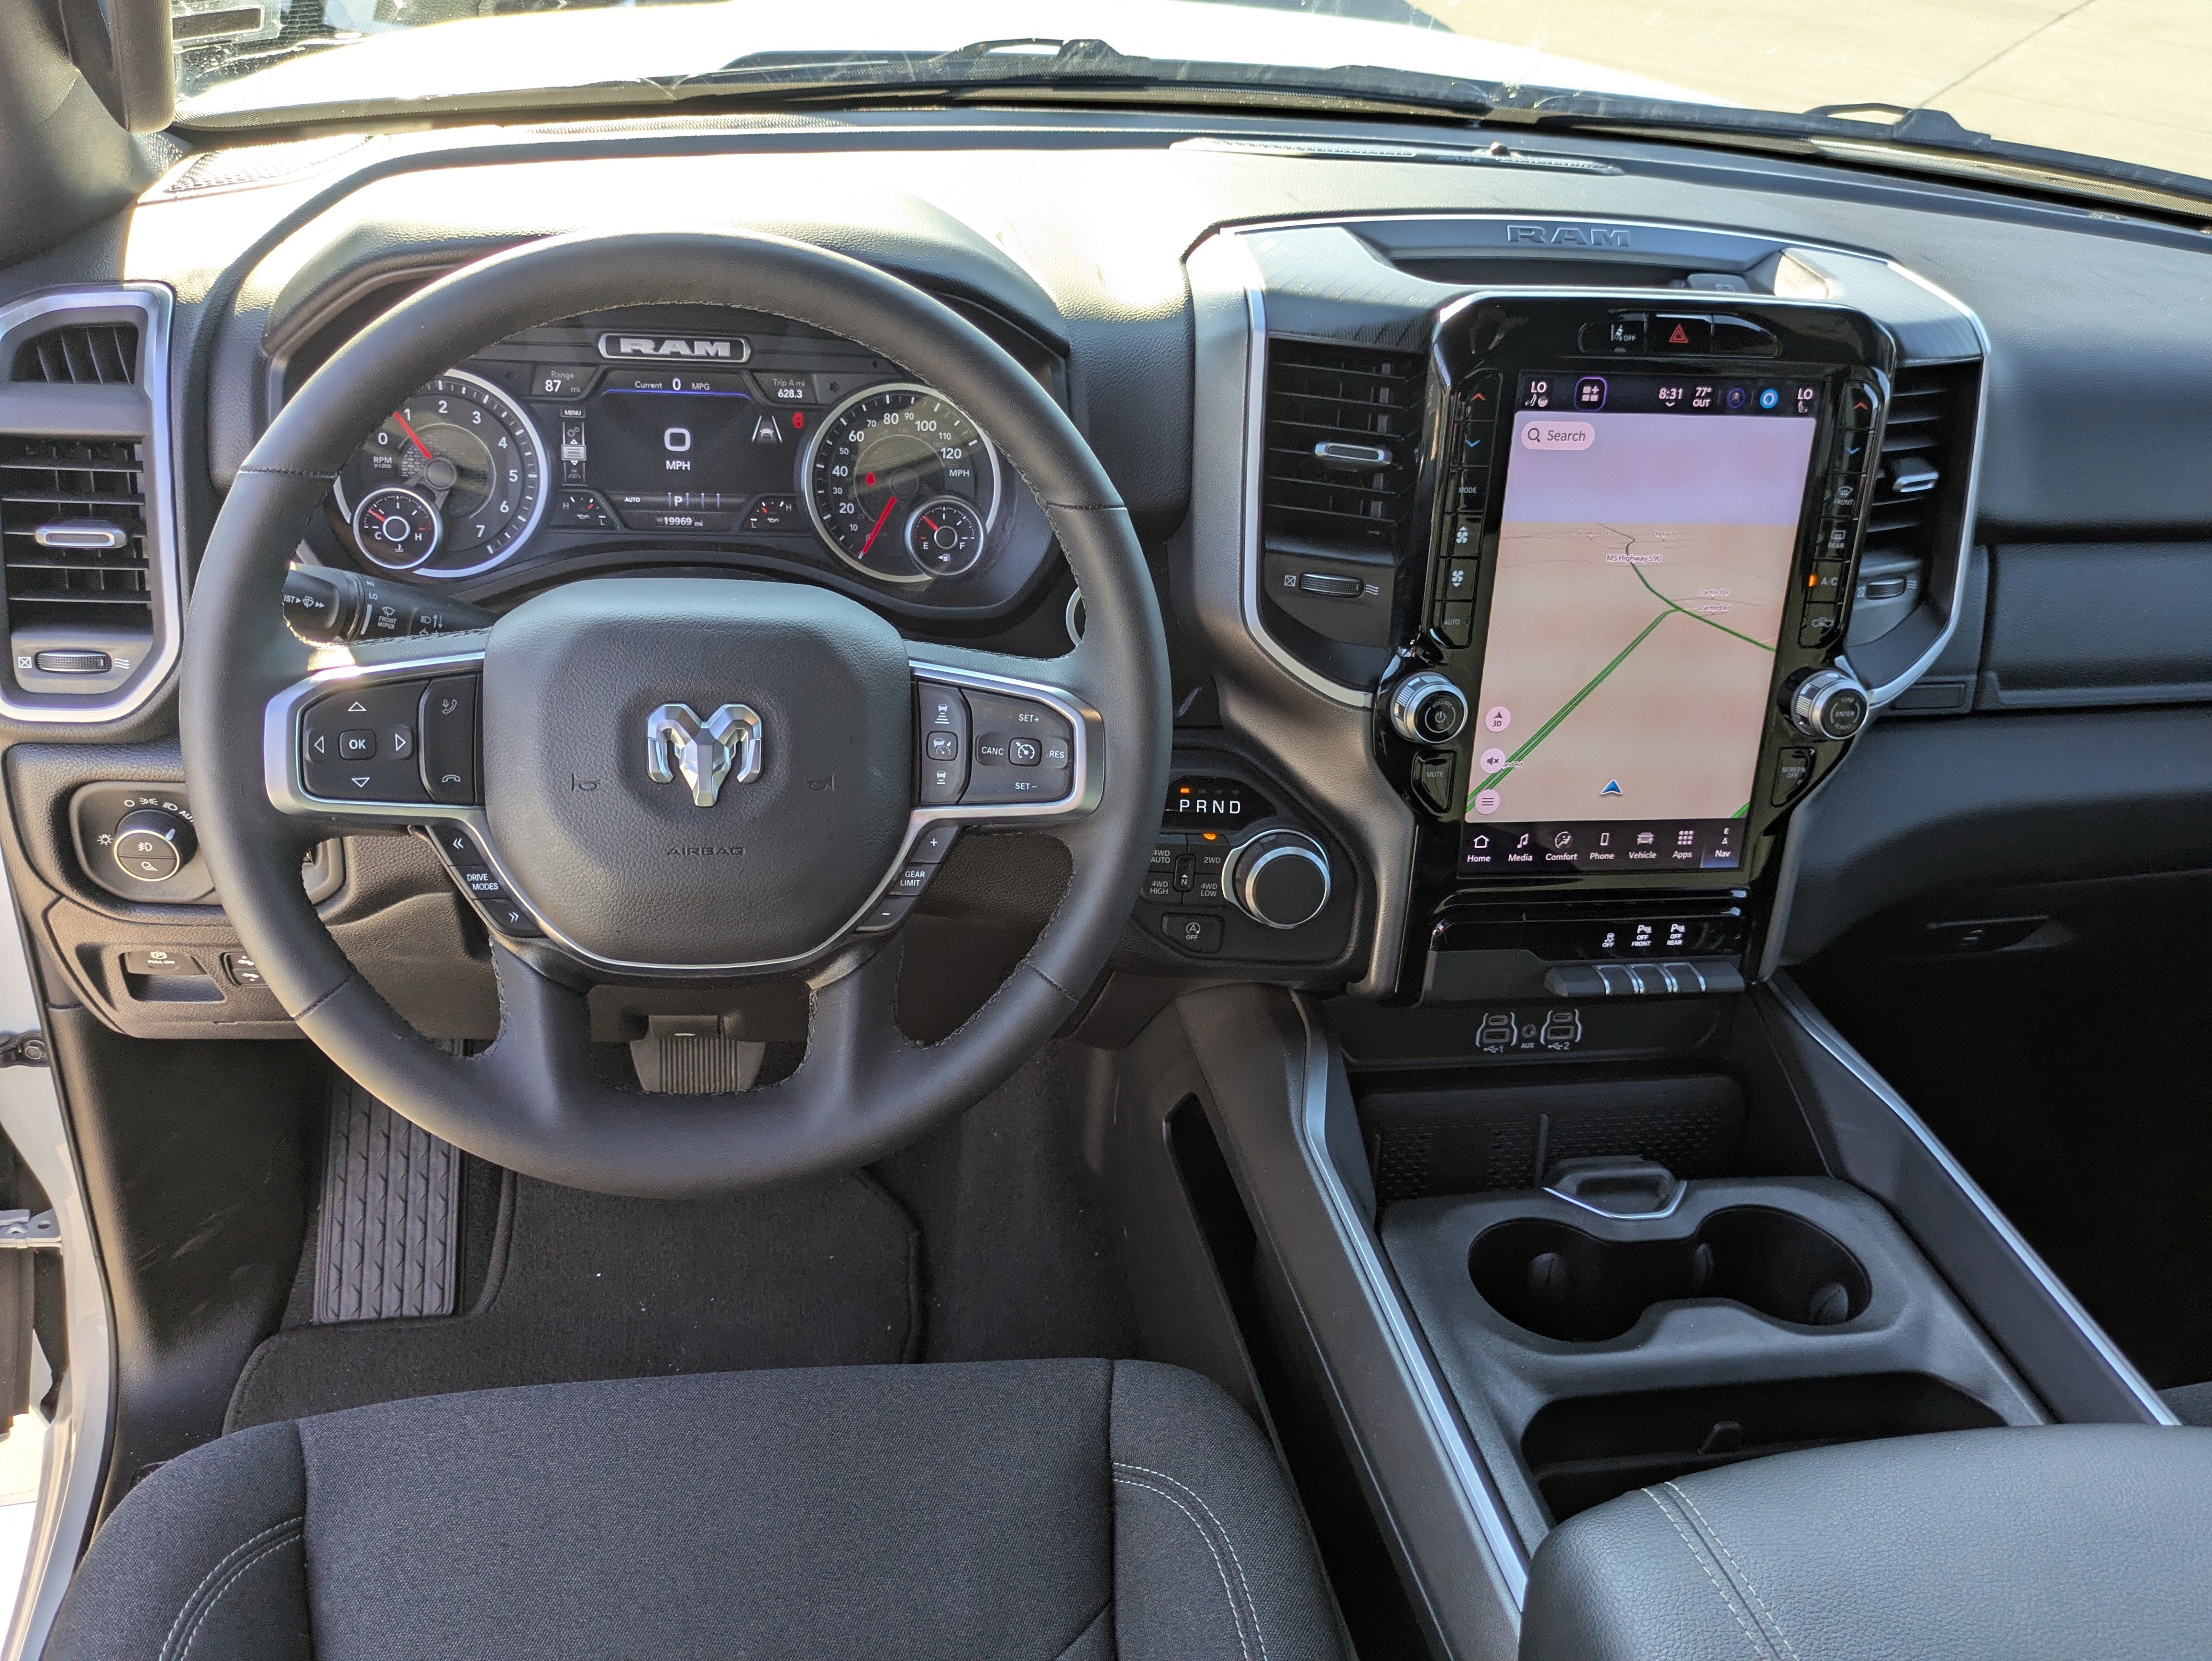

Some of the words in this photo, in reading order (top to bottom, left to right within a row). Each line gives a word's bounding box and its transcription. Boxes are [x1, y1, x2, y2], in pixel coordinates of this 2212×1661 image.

[1507, 224, 1630, 247] RAM
[619, 338, 731, 358] RAM
[551, 371, 574, 380] Range
[545, 379, 561, 392] 87
[635, 381, 663, 389] Current
[672, 378, 681, 391] 0
[692, 383, 710, 391] MPG
[773, 379, 787, 388] Trip
[1531, 381, 1547, 393] LO
[777, 389, 803, 399] 628.3
[1659, 388, 1683, 399] 8:31
[1797, 388, 1814, 399] LO
[438, 401, 448, 413] 2
[1692, 399, 1711, 407] OUT
[404, 409, 410, 421] 1
[472, 411, 481, 424] 3
[884, 413, 899, 424] 80
[915, 421, 937, 432] 100
[378, 432, 388, 445] 0
[664, 428, 691, 451] 0
[849, 431, 864, 442] 60
[939, 432, 951, 440] 110
[1547, 430, 1585, 442] Search
[498, 437, 508, 449] 4
[940, 448, 962, 459] 120
[666, 461, 690, 471] MPH
[832, 465, 848, 477] 40
[509, 470, 518, 482] 5
[500, 501, 509, 513] 6
[674, 496, 683, 507] P
[839, 503, 854, 514] 20
[664, 517, 692, 525] 19969
[375, 531, 382, 541] C
[415, 532, 422, 541] H
[476, 525, 486, 537] 7
[1821, 577, 1838, 586] A/C
[283, 595, 296, 603] IST
[378, 615, 397, 624] FRONT
[378, 621, 395, 630] WIPER
[1431, 699, 1453, 709] VOLUME
[349, 739, 366, 750] OK
[982, 746, 1004, 756] CANC
[1050, 750, 1065, 759] RES
[178, 810, 194, 822] AU
[666, 846, 745, 856] AIRBAG
[1628, 851, 1657, 859] Vehicle
[1672, 851, 1692, 859] Apps
[1467, 854, 1491, 863] Home
[1545, 853, 1578, 861] Comfort
[466, 873, 488, 881] DRIVE
[905, 871, 925, 879] GEAR
[1500, 1045, 1504, 1053] 1
[1563, 1041, 1570, 1050] 2
